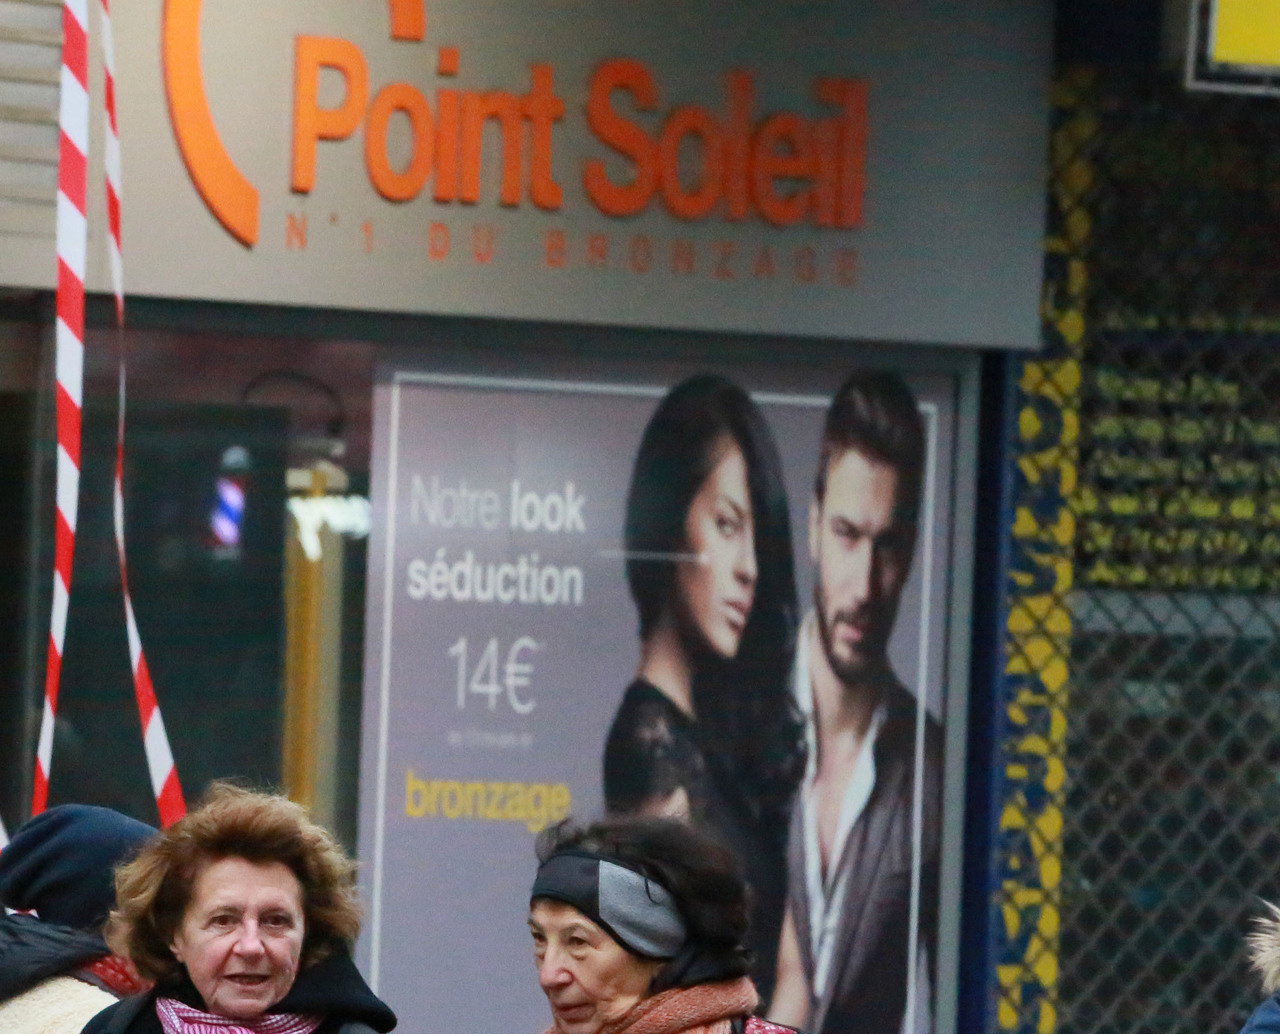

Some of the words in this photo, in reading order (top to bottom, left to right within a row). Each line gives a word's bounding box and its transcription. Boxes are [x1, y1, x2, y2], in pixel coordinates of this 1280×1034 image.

[290, 35, 565, 211] Point
[582, 58, 870, 231] Soleil
[427, 222, 495, 264] DU
[543, 229, 860, 288] BRONZAGE
[410, 474, 502, 531] Notre
[509, 478, 587, 534] look
[407, 547, 585, 606] séduction
[448, 636, 539, 715] 14€
[405, 768, 573, 834] bronzage
